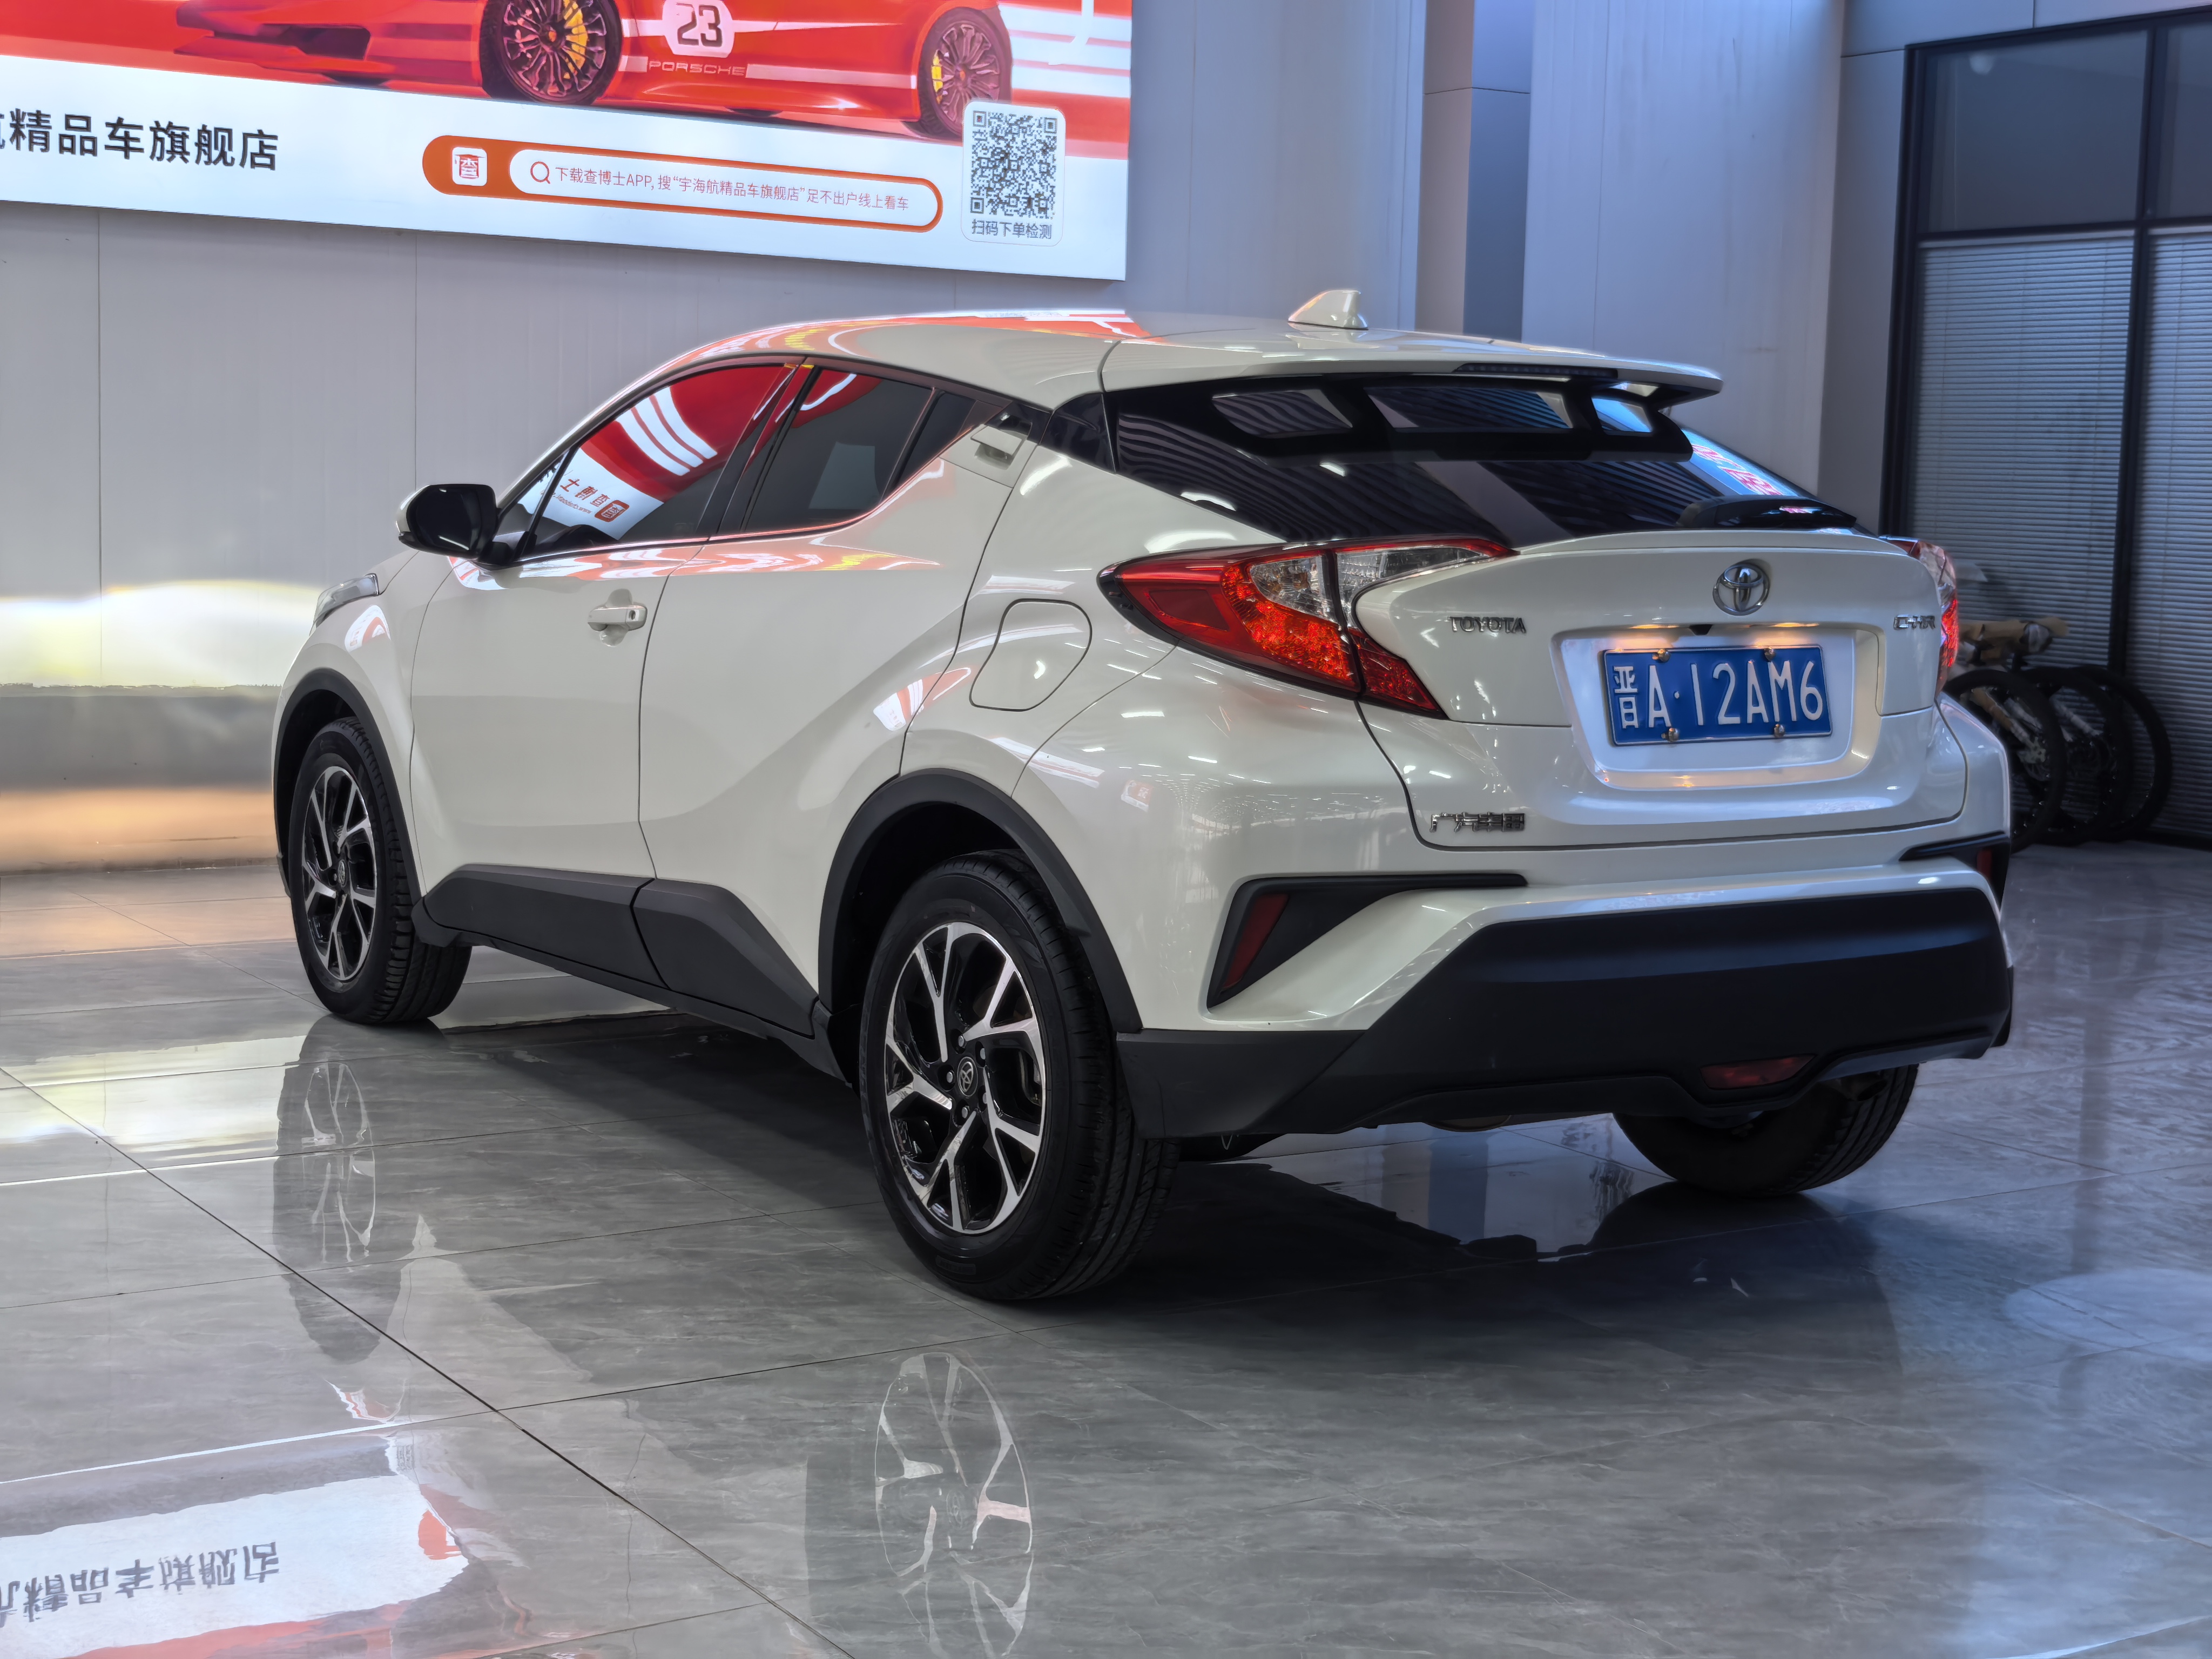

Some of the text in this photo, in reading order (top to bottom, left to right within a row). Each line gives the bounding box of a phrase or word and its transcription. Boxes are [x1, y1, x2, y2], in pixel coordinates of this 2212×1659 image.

[676, 2, 723, 48] 23
[649, 60, 746, 76] PORSCHE
[0, 108, 279, 171] 精品车旗舰店
[972, 218, 1053, 239] 扫码下单检测
[1448, 616, 1527, 634] TOYOTA
